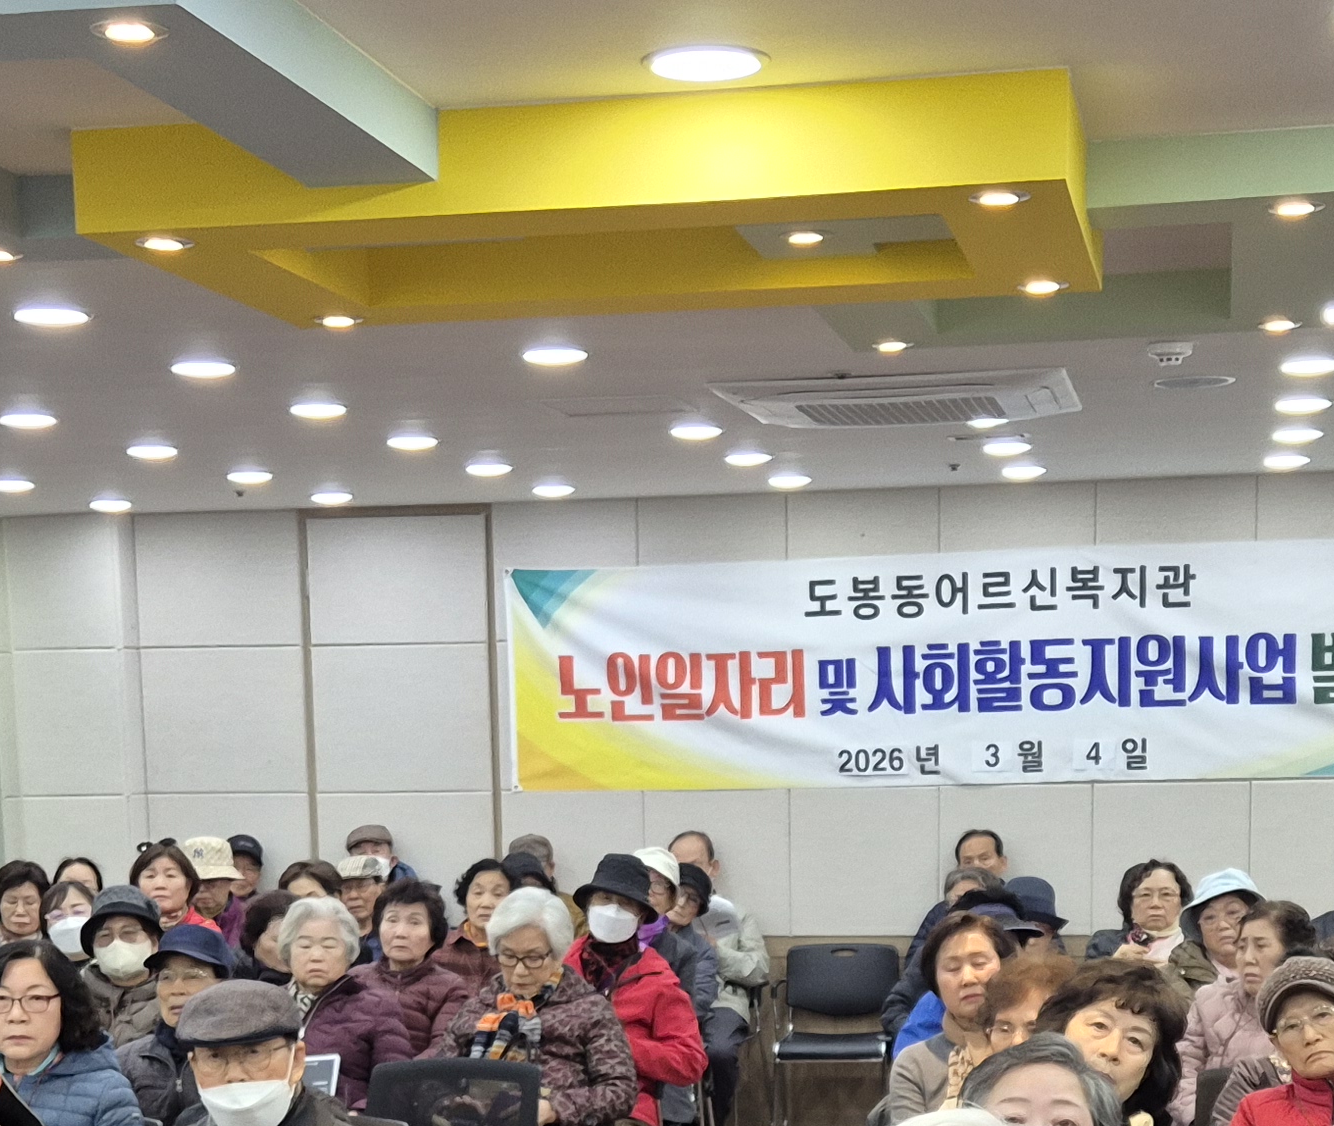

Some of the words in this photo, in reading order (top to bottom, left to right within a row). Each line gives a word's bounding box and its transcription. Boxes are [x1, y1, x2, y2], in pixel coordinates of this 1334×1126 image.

[804, 563, 1196, 621] 도봉동어르신복지관
[558, 648, 806, 722] 노인일자리
[817, 657, 859, 716] 및
[867, 631, 1297, 715] 사회활동지원사업
[838, 747, 905, 774] 2026
[915, 743, 941, 775] 년
[984, 743, 1000, 768] 3
[1017, 740, 1043, 773] 월
[1086, 741, 1102, 766] 4
[1121, 737, 1148, 771] 일
